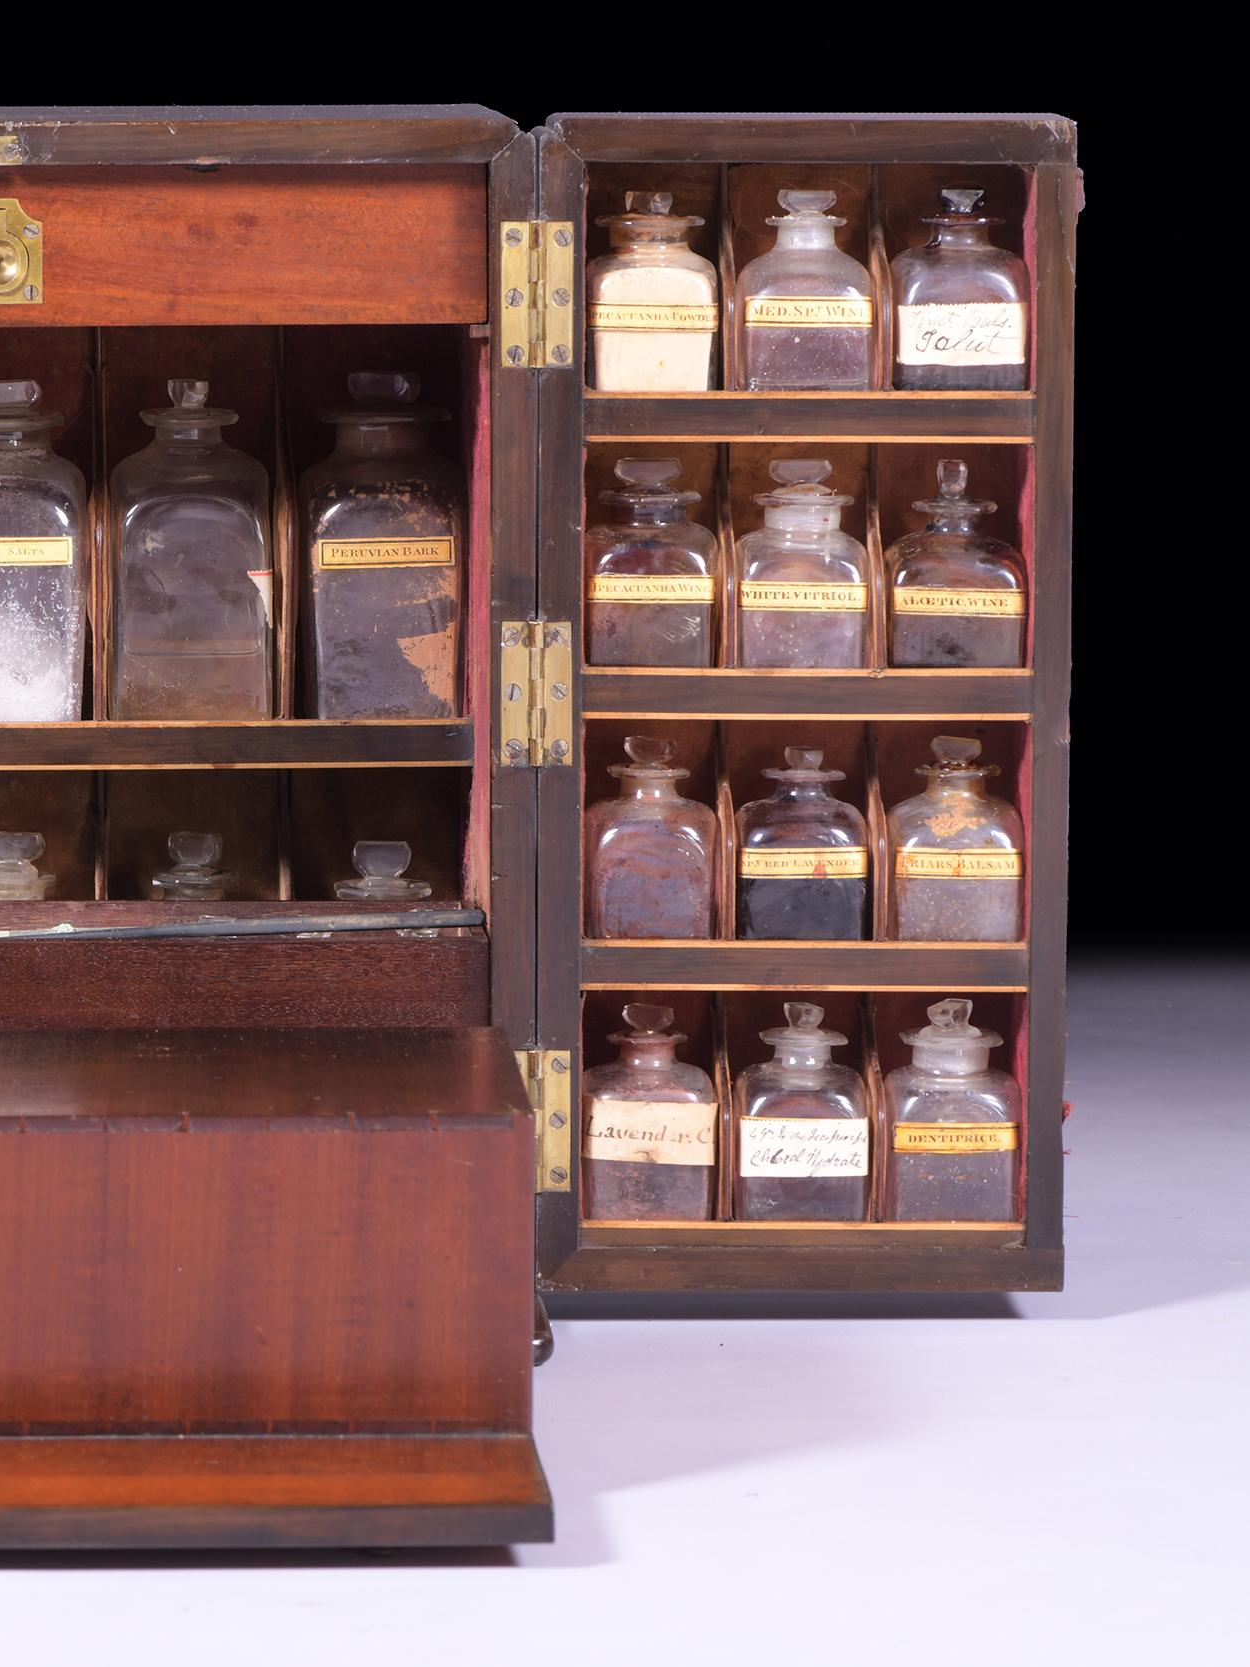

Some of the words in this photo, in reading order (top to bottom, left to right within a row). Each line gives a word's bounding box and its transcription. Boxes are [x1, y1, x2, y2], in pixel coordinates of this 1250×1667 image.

[7, 547, 45, 556] SALTS
[331, 547, 399, 558] PERUVIAN
[402, 546, 440, 557] BARK
[591, 582, 676, 593] IPECACUANHA
[793, 858, 860, 868] LAVENDER
[957, 857, 1015, 870] BALSAM
